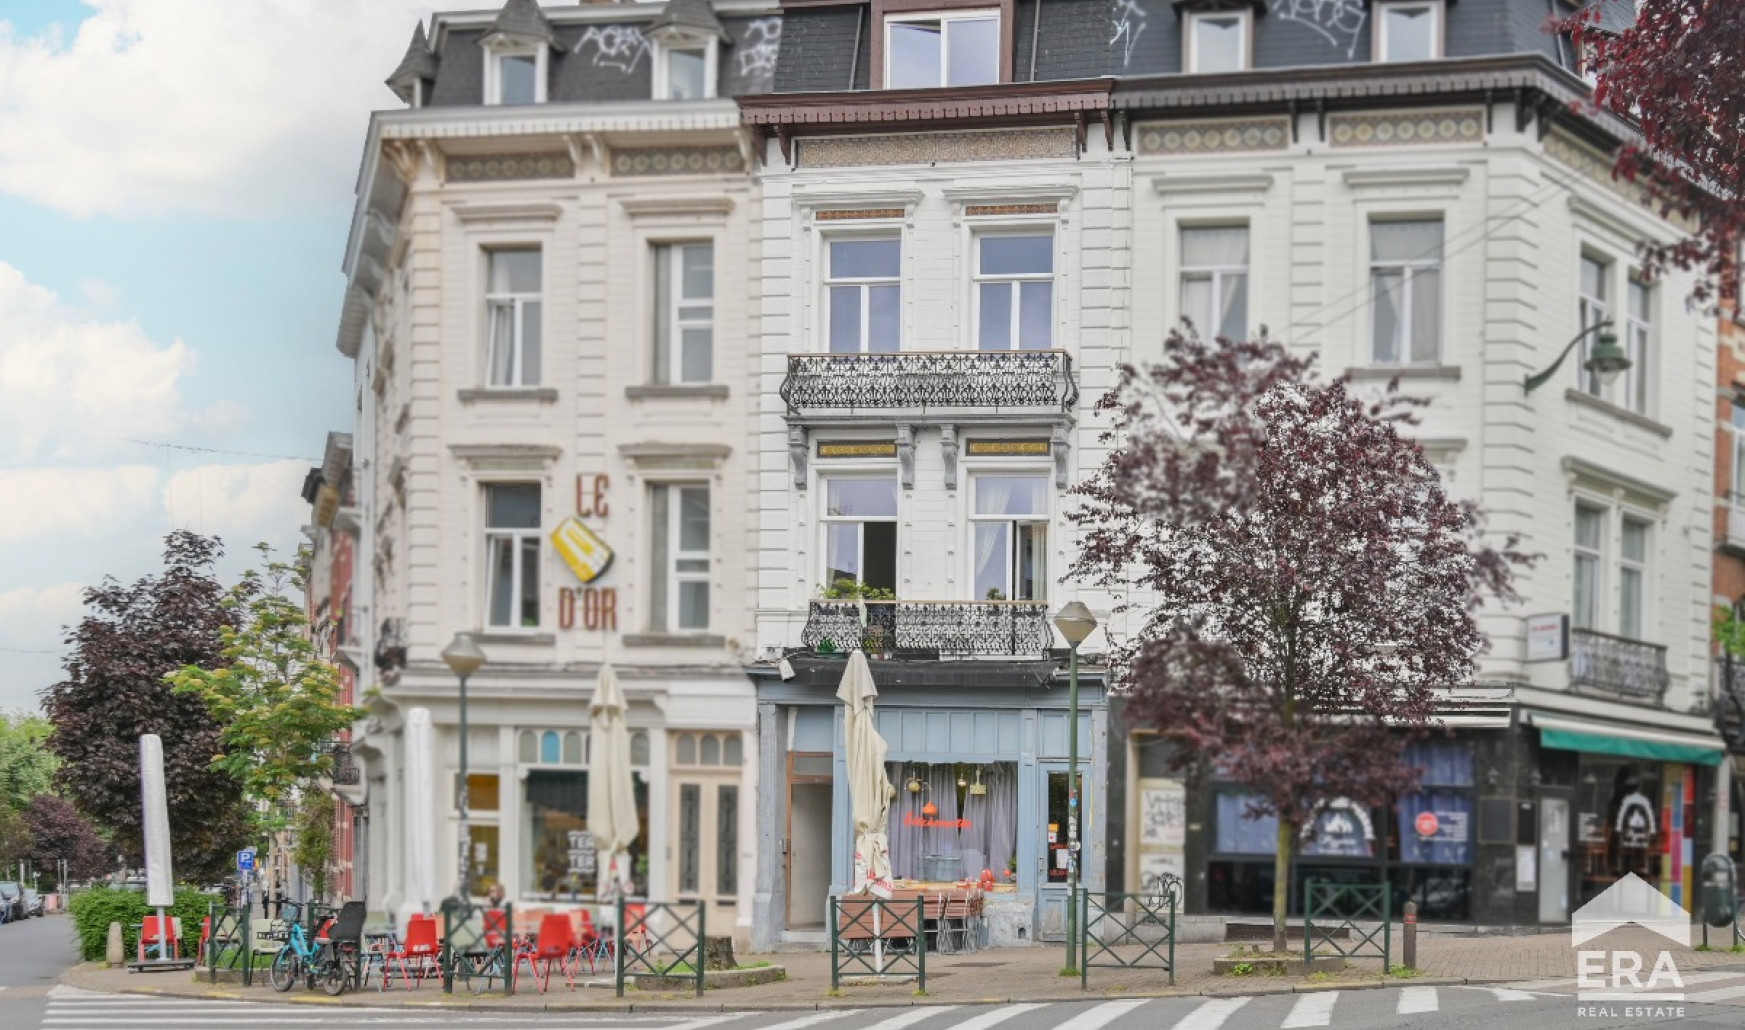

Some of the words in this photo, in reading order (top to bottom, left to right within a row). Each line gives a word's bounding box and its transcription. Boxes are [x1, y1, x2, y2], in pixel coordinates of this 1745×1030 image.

[576, 473, 609, 517] LE
[558, 586, 617, 632] D'OR
[240, 852, 251, 863] P
